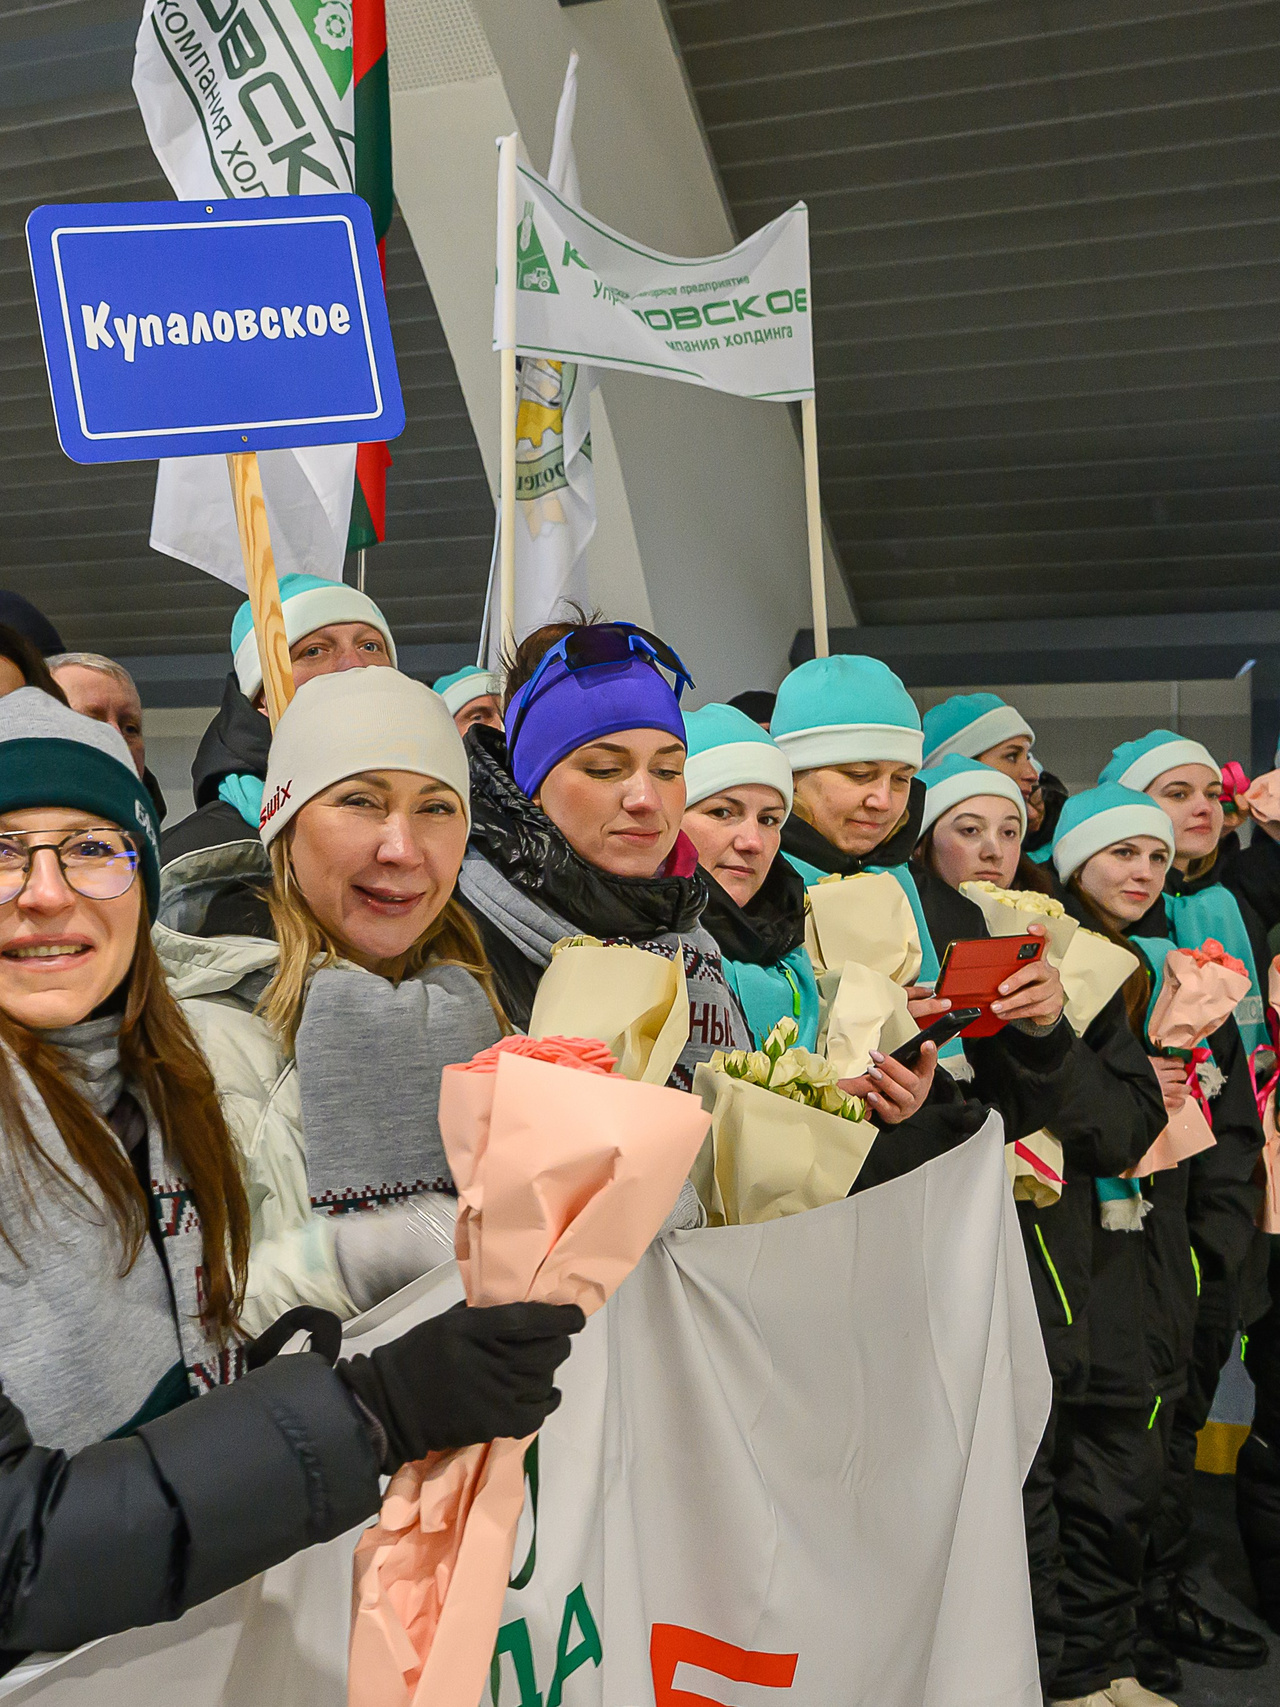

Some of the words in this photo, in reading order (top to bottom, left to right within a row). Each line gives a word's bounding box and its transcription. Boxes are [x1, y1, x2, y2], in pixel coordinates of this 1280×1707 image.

[680, 275, 750, 295] предприятие
[80, 301, 351, 363] Купаловское
[724, 325, 793, 347] холдинга
